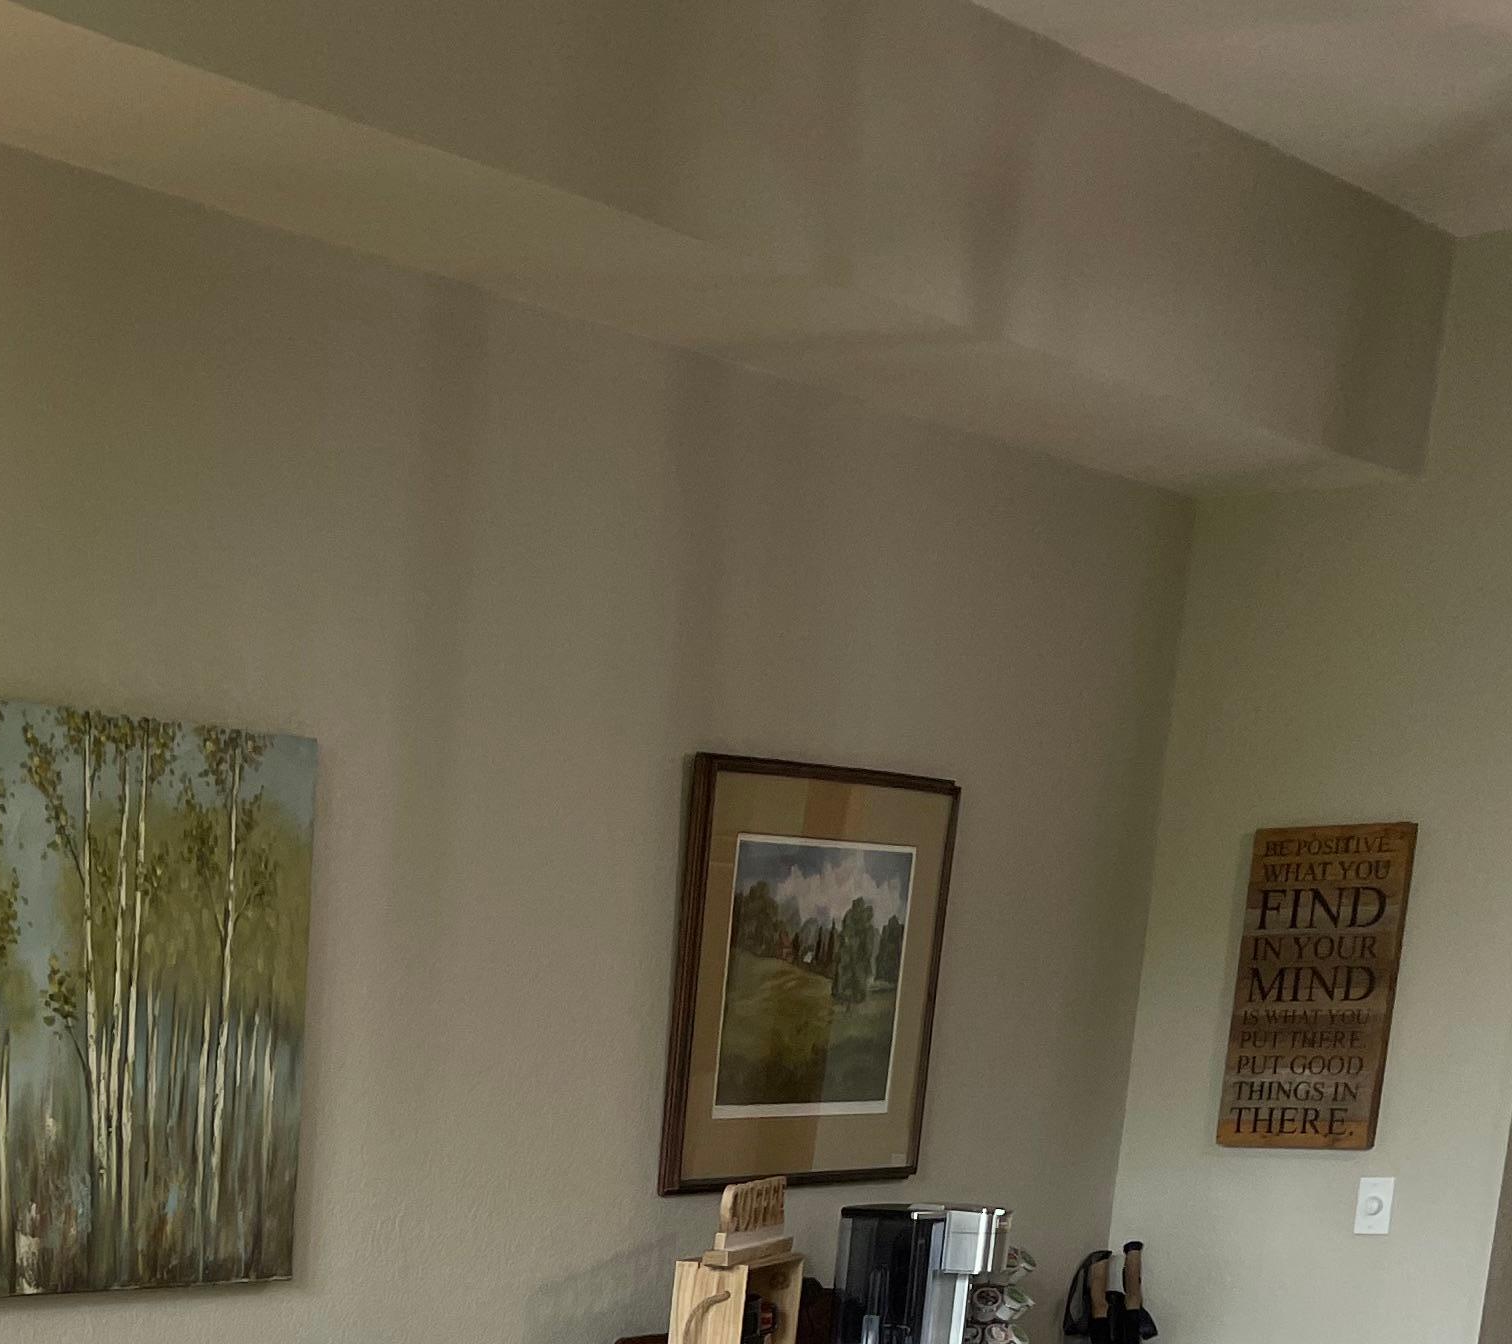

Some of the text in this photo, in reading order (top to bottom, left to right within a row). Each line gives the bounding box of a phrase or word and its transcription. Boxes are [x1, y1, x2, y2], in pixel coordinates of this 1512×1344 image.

[1265, 835, 1389, 857] BE POSITIVE
[1264, 860, 1391, 882] WHAT YOU
[1257, 885, 1387, 930] FIND
[1252, 936, 1377, 961] IN YOUR
[1248, 966, 1376, 1002] MIND
[1242, 1008, 1371, 1025] IS WHAT YOU
[1239, 1031, 1284, 1049] PUT
[1237, 1055, 1364, 1075] PUT GOOD
[1232, 1081, 1358, 1102] THINGS IN
[1230, 1107, 1354, 1136] THERE.
